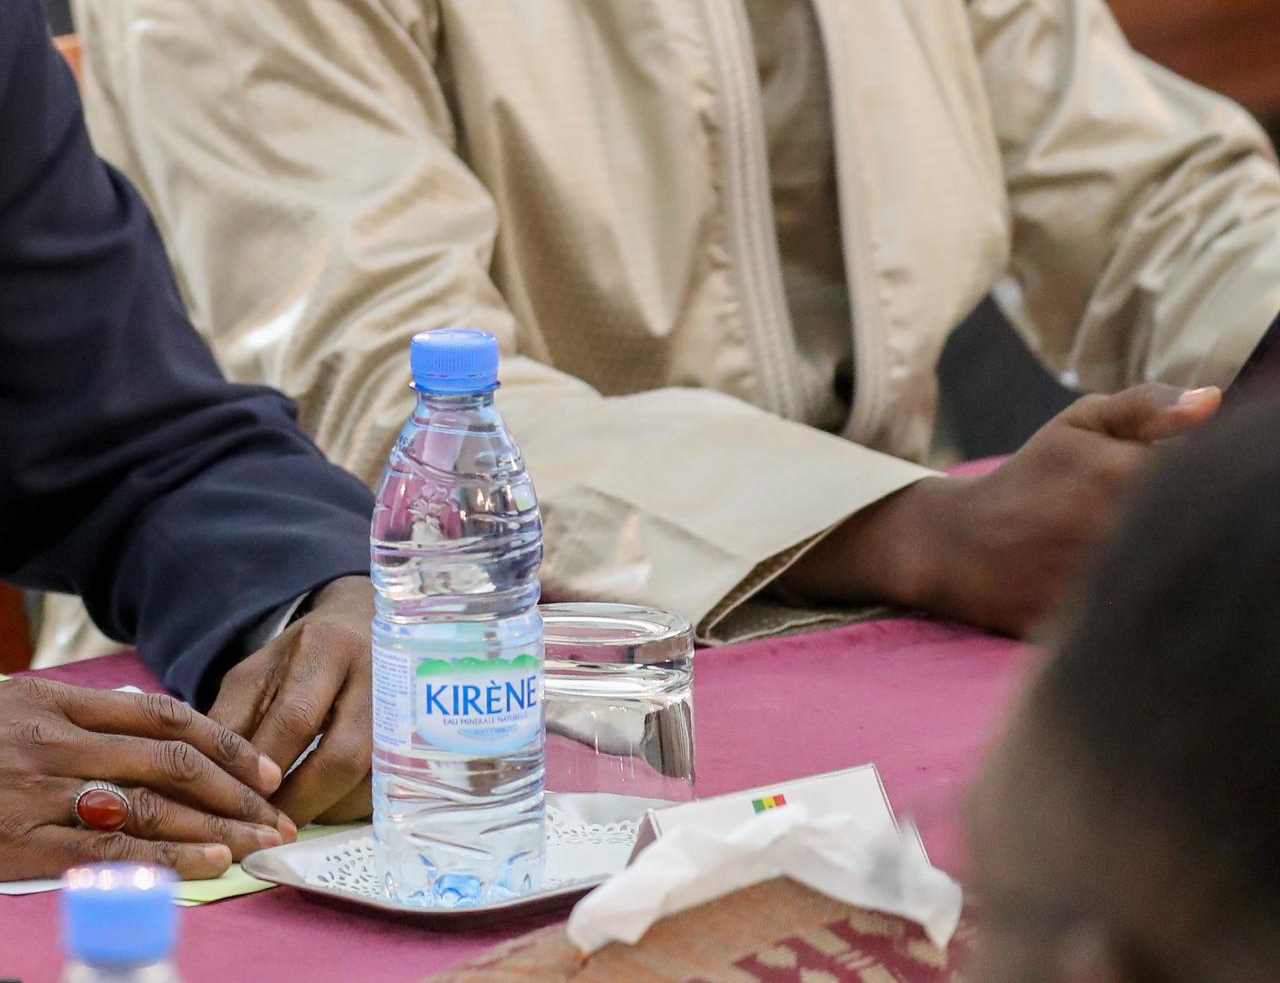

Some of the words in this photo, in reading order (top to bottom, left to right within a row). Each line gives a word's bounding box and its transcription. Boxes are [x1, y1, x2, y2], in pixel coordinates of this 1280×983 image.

[426, 675, 536, 715] KIRÈNE
[443, 718, 459, 726] EAU
[497, 713, 528, 723] NATUR
